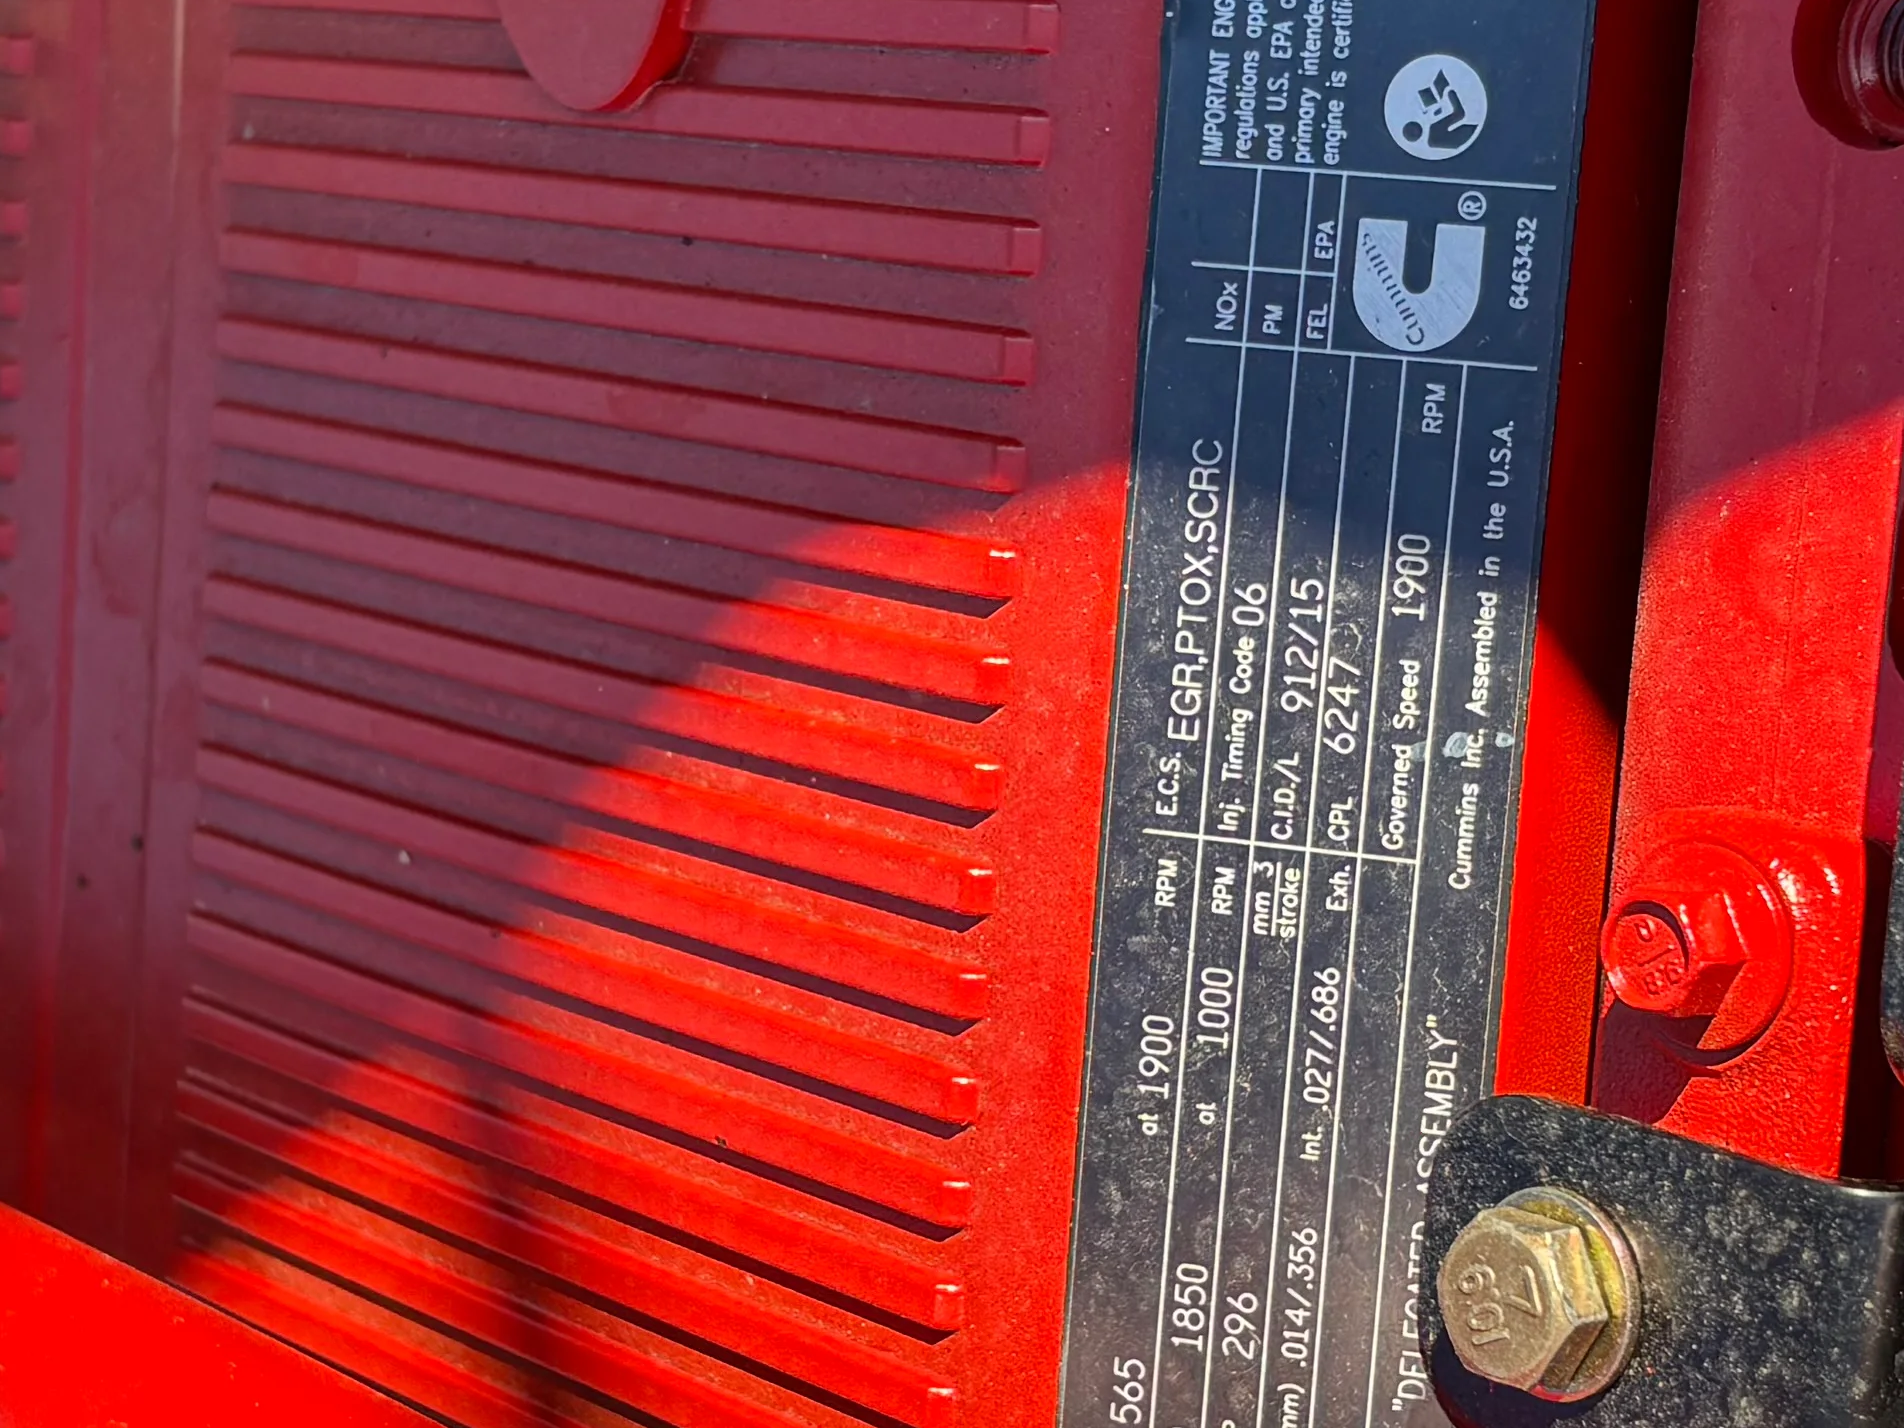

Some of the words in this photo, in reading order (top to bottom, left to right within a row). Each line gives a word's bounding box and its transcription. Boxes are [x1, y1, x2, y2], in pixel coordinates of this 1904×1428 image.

[1268, 19, 1294, 59] EPA
[1201, 47, 1231, 157] IMPORTANT
[1232, 49, 1260, 159] regulations
[1265, 71, 1290, 111] U.S.
[1329, 69, 1348, 88] is
[1263, 122, 1285, 161] and
[1290, 86, 1322, 164] primary
[1320, 98, 1348, 165] engine
[1313, 219, 1335, 260] EPA
[1507, 215, 1538, 310] 6463432
[1213, 281, 1238, 331] NOx
[1261, 303, 1283, 335] PM
[1304, 302, 1328, 339] FEL
[1420, 382, 1446, 434] RPM
[1485, 419, 1514, 487] U.S.A.
[1481, 501, 1507, 540] the
[1166, 438, 1222, 742] EGR,PTOX,SCRC
[1390, 533, 1431, 621] 1900
[1477, 555, 1501, 577] in
[1230, 582, 1267, 627] 06
[1227, 634, 1256, 694] Code
[1279, 576, 1325, 713] 912/15
[1463, 590, 1498, 717] Assembled
[1321, 654, 1361, 755] 6247
[1391, 658, 1421, 730] Speed
[1220, 707, 1254, 782] Timing
[1457, 727, 1487, 769] Inc.
[1154, 750, 1182, 816] E.C.S.
[1216, 796, 1246, 832] Inj.
[1269, 750, 1301, 841] C.I.D./L
[1380, 742, 1415, 850] Governed
[1326, 795, 1353, 842] CPL
[1446, 781, 1480, 890] Cummins
[1153, 857, 1178, 907] RPM
[1210, 865, 1236, 916] RPM
[1248, 855, 1274, 878] 3
[1324, 863, 1352, 912] Exh.
[1251, 890, 1272, 936] mm
[1272, 862, 1301, 939] stroke
[1195, 965, 1234, 1049] 1000
[1136, 1013, 1175, 1100] 1900
[1301, 966, 1341, 1116] .027/.686
[1137, 1112, 1159, 1136] at
[1194, 1101, 1218, 1126] at
[1298, 1125, 1324, 1162] Int.
[1169, 1262, 1209, 1352] 1850
[1220, 1291, 1259, 1360] 296
[1108, 1355, 1146, 1424] 565
